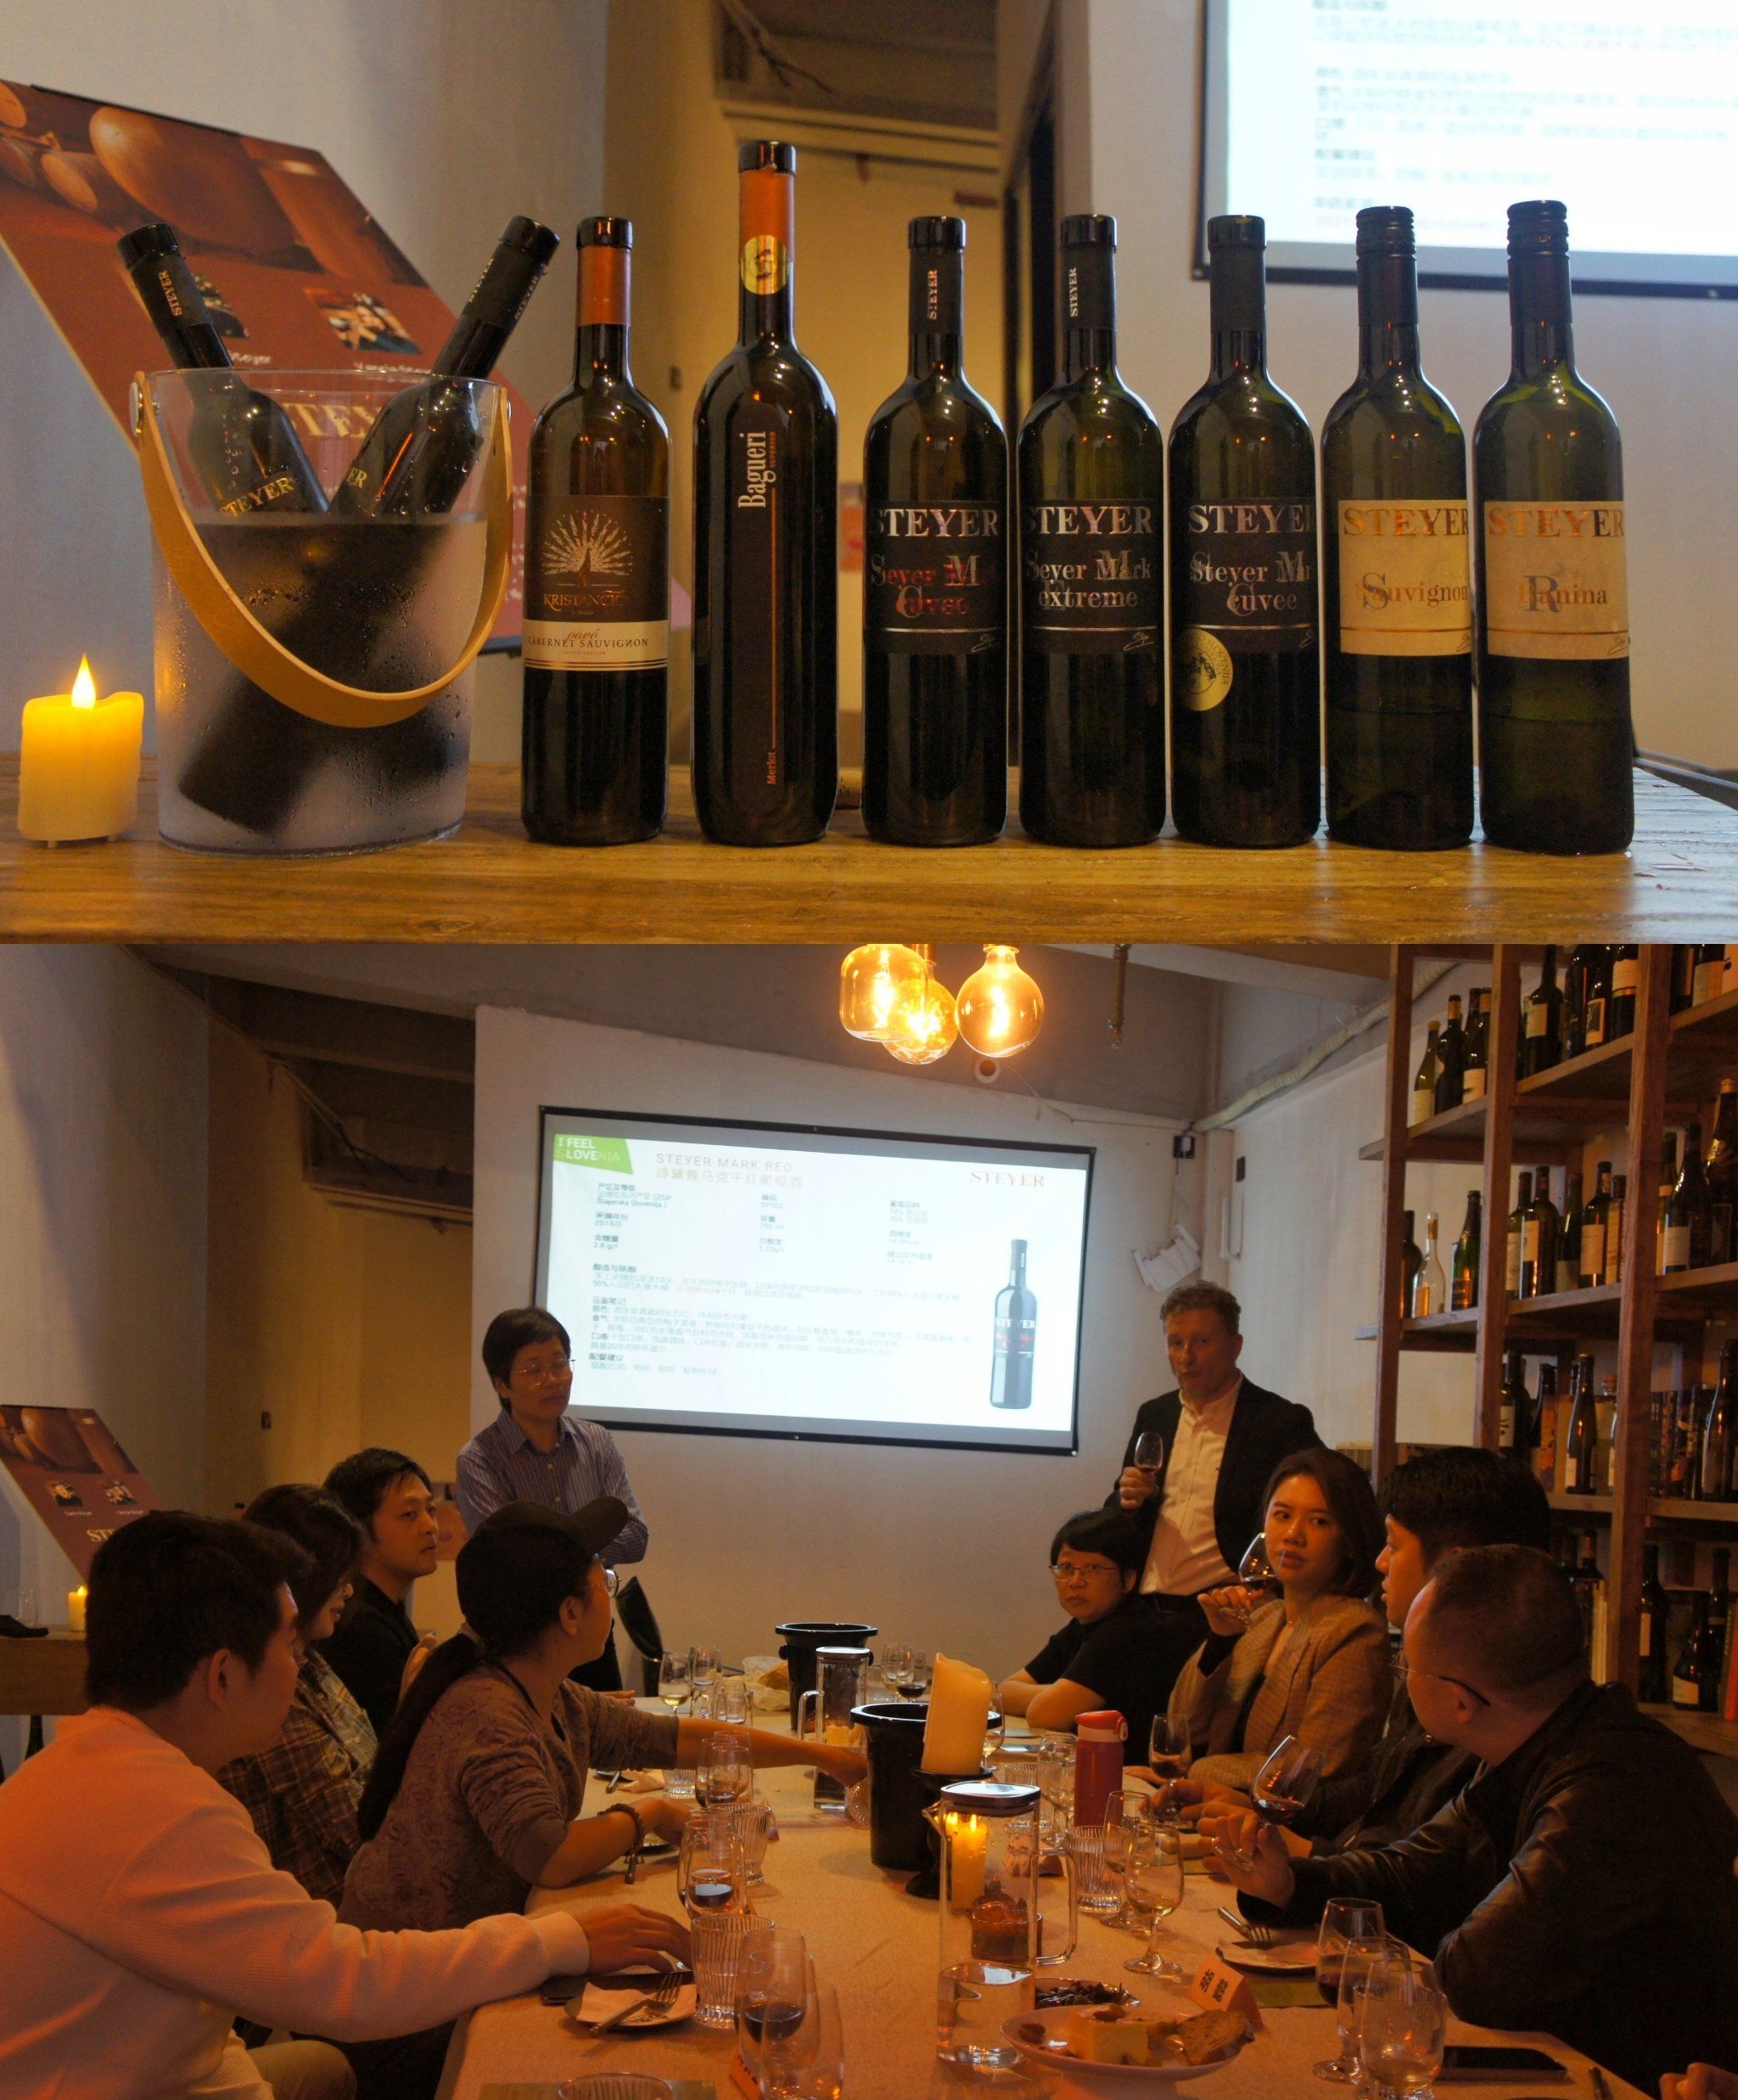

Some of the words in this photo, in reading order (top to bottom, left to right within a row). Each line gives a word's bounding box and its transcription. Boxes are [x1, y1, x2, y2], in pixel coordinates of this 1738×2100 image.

[157, 270, 182, 316] STEYER
[1068, 267, 1079, 317] STEYER
[1488, 508, 1625, 537] STEYER
[528, 637, 575, 648] CABERNET
[579, 637, 649, 649] SAUVIGNON
[766, 752, 776, 784] Merlot
[557, 1137, 564, 1147] I
[566, 1137, 596, 1149] FEEL
[656, 1153, 711, 1167] STEYER
[717, 1157, 759, 1171] MARK
[765, 1160, 793, 1172] RED
[970, 1171, 1046, 1188] STEYER
